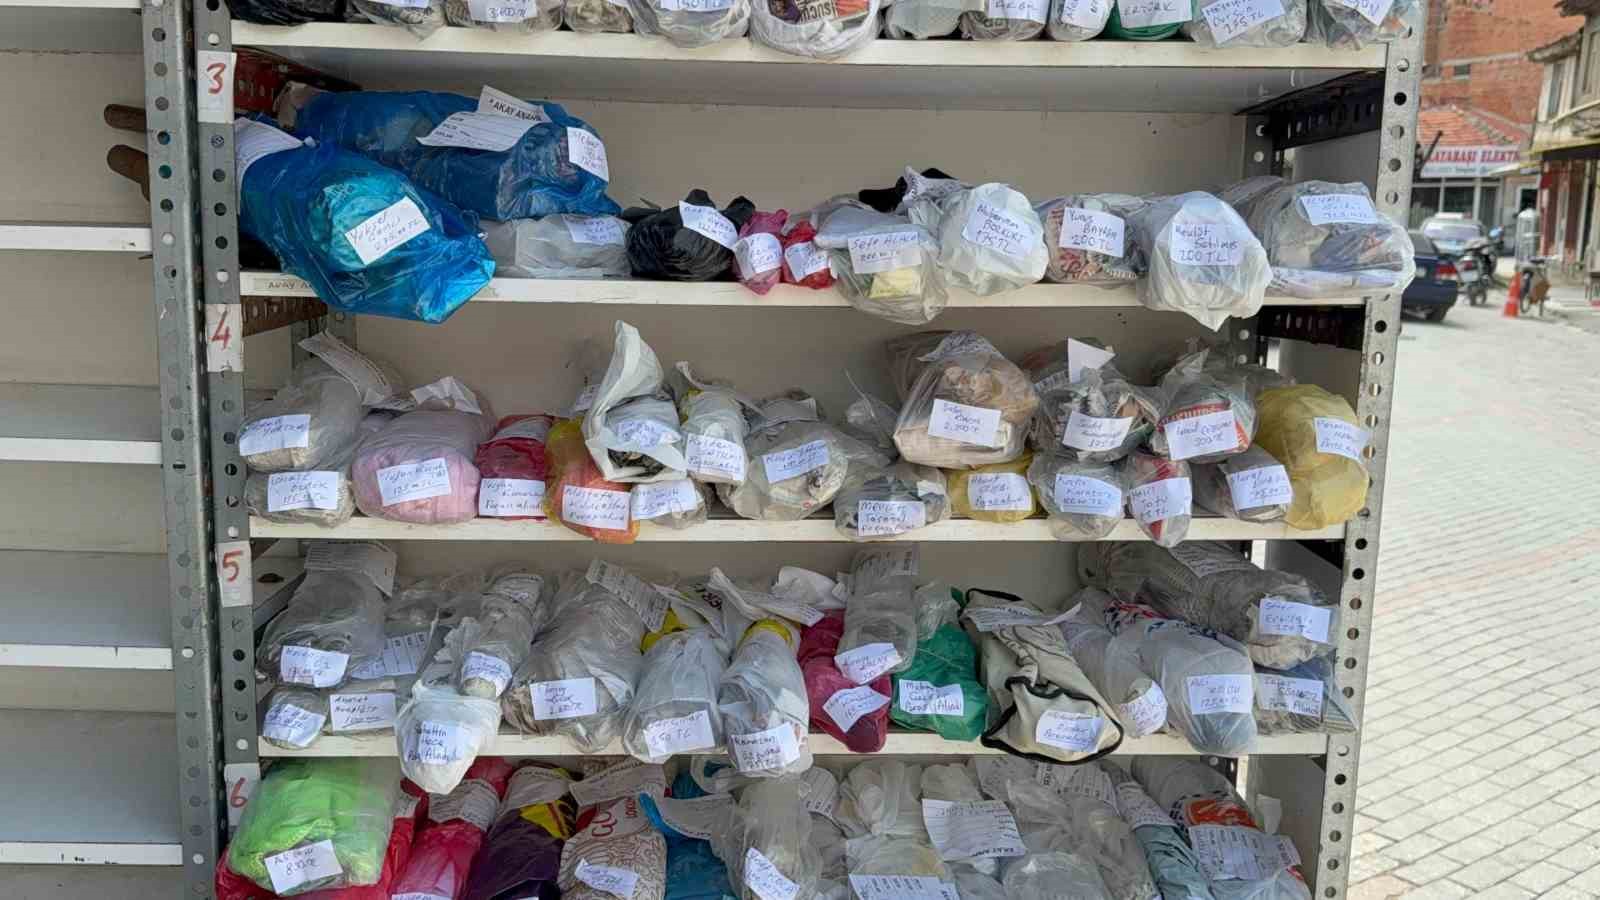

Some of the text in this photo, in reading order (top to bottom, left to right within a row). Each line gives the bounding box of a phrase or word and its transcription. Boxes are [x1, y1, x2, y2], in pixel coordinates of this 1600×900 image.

[207, 62, 226, 94] 3
[211, 308, 231, 351] 4
[222, 549, 245, 583] 5
[230, 776, 249, 809] 6
